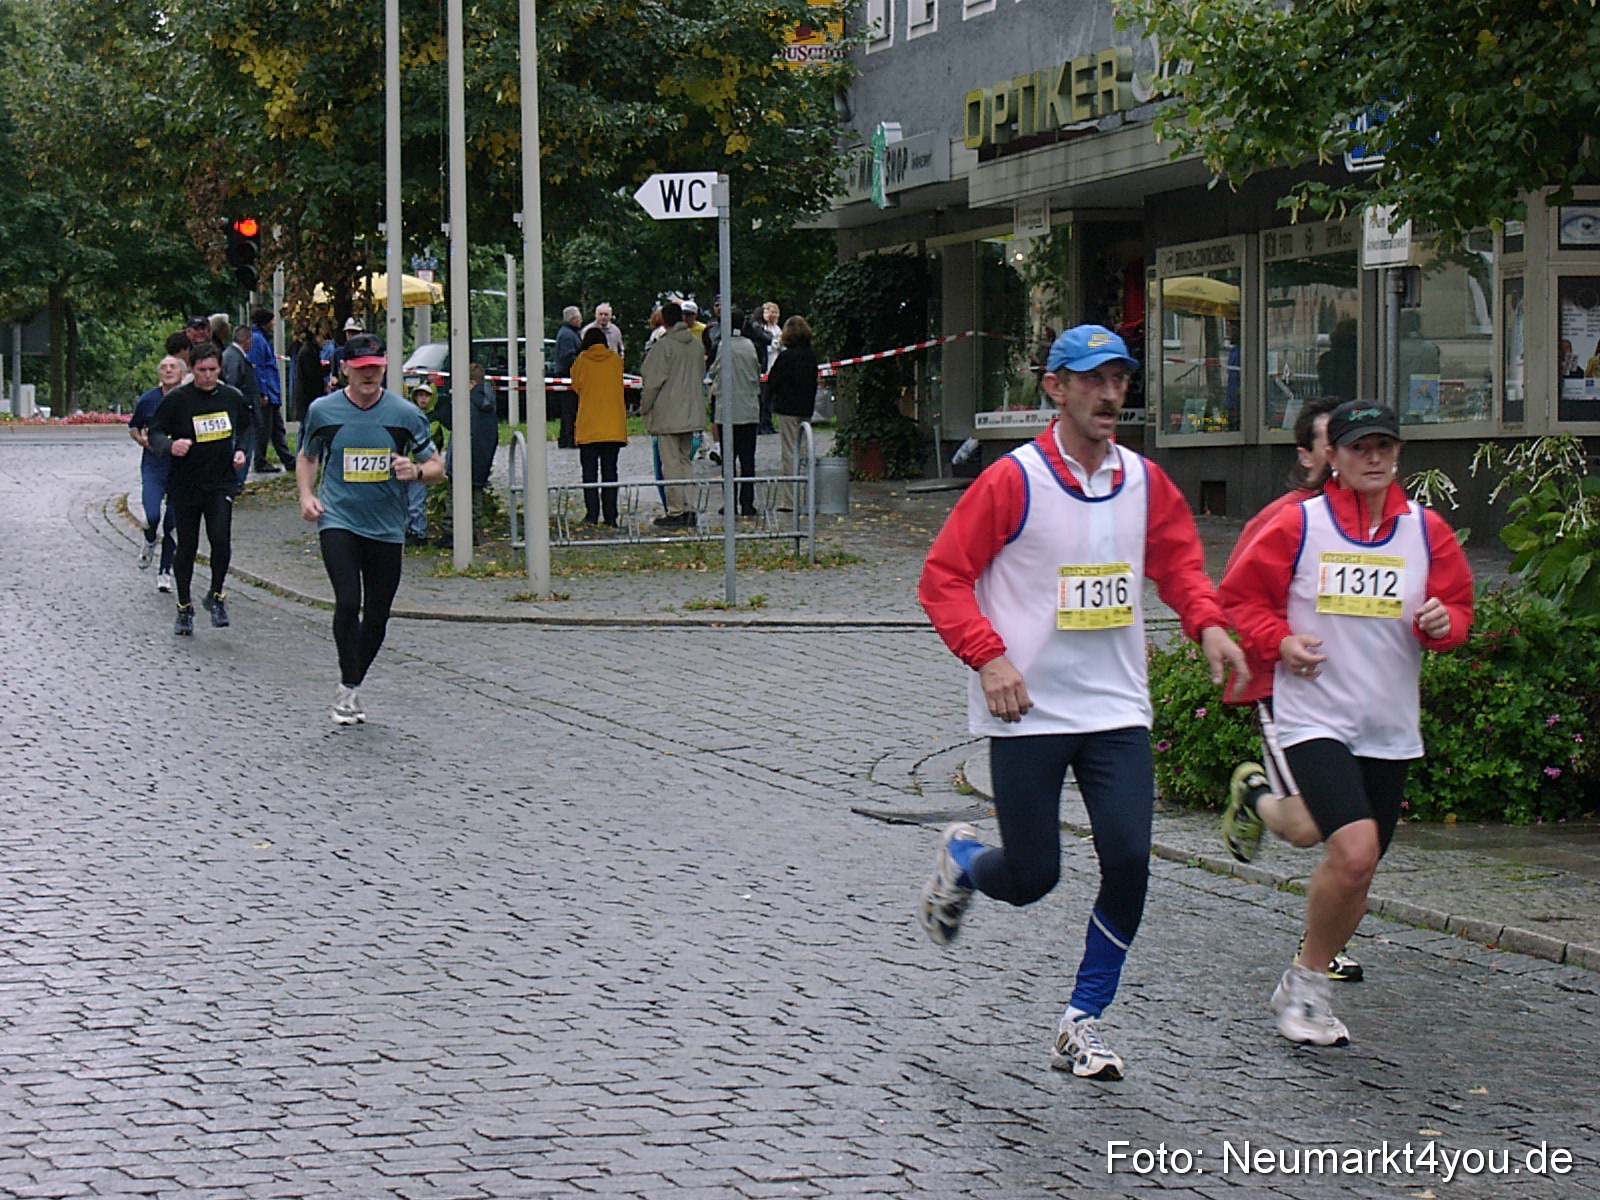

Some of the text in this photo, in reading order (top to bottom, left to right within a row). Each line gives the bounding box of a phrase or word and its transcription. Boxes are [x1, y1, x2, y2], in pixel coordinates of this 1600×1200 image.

[964, 46, 1130, 149] OPTIKER
[659, 179, 706, 213] WC
[203, 418, 227, 432] 1519
[352, 456, 387, 471] 1275
[1075, 577, 1128, 608] 1316
[1335, 566, 1398, 597] 1312
